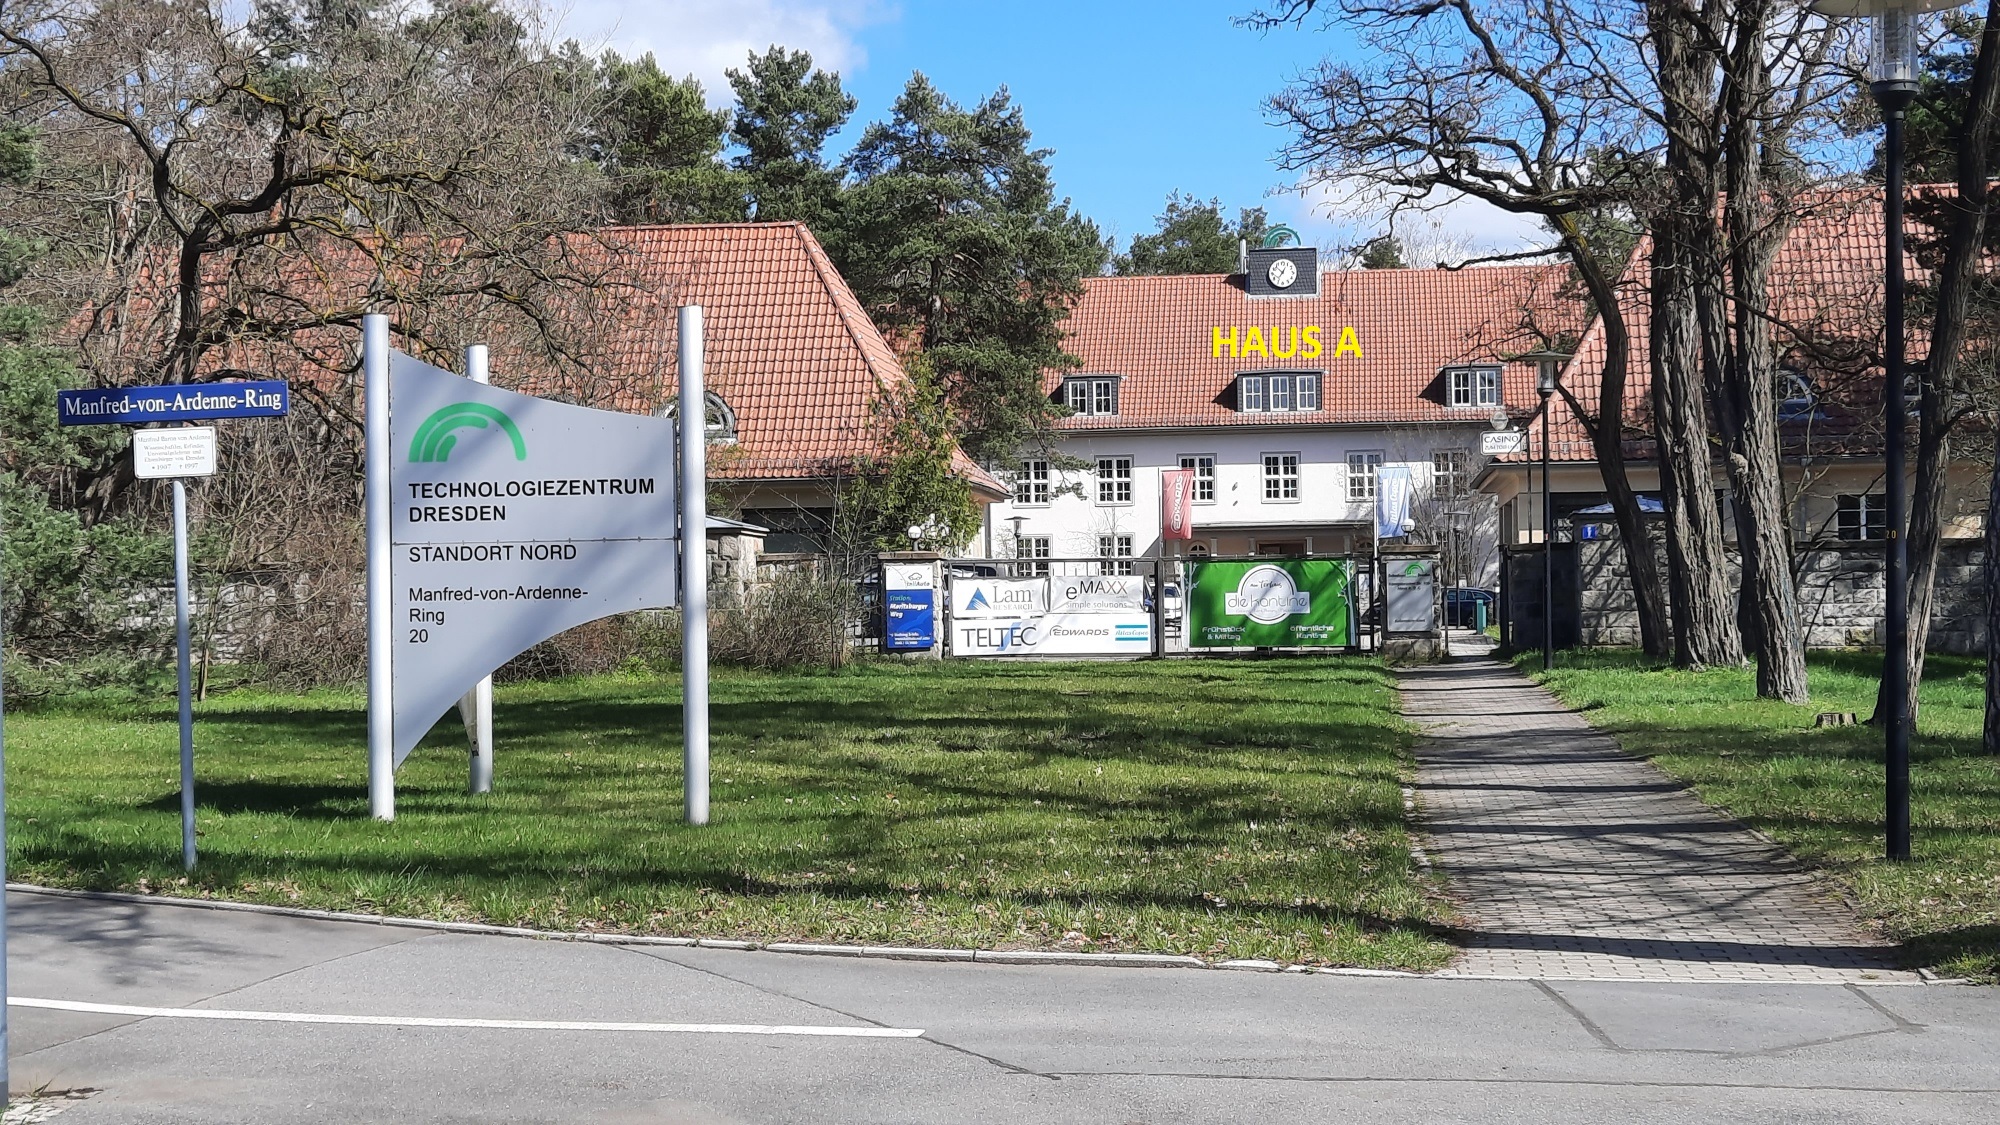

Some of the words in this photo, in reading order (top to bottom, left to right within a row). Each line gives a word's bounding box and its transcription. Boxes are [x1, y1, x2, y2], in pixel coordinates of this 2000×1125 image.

[64, 389, 283, 416] Manfred-von-Ardenne-Ring
[1484, 435, 1519, 444] CASINO
[408, 478, 655, 499] TECHNOLOGIEZENTRUM
[1171, 473, 1183, 533] EDWARDS
[408, 505, 506, 522] DRESDEN
[408, 545, 514, 563] STANDORT
[520, 544, 577, 561] NORD
[409, 585, 589, 603] Manfred-von-Ardenne-
[993, 585, 1033, 603] Lam
[1065, 580, 1128, 600] eMAXX
[1066, 600, 1091, 609] simple
[1093, 600, 1128, 609] solutions
[1228, 594, 1248, 608] die
[1250, 594, 1308, 608] kantine
[409, 608, 446, 626] Ring
[408, 628, 429, 644] 20
[960, 626, 1037, 648] TELTEC
[1051, 627, 1110, 637] EDWARDS
[1214, 633, 1241, 641] Mittag
